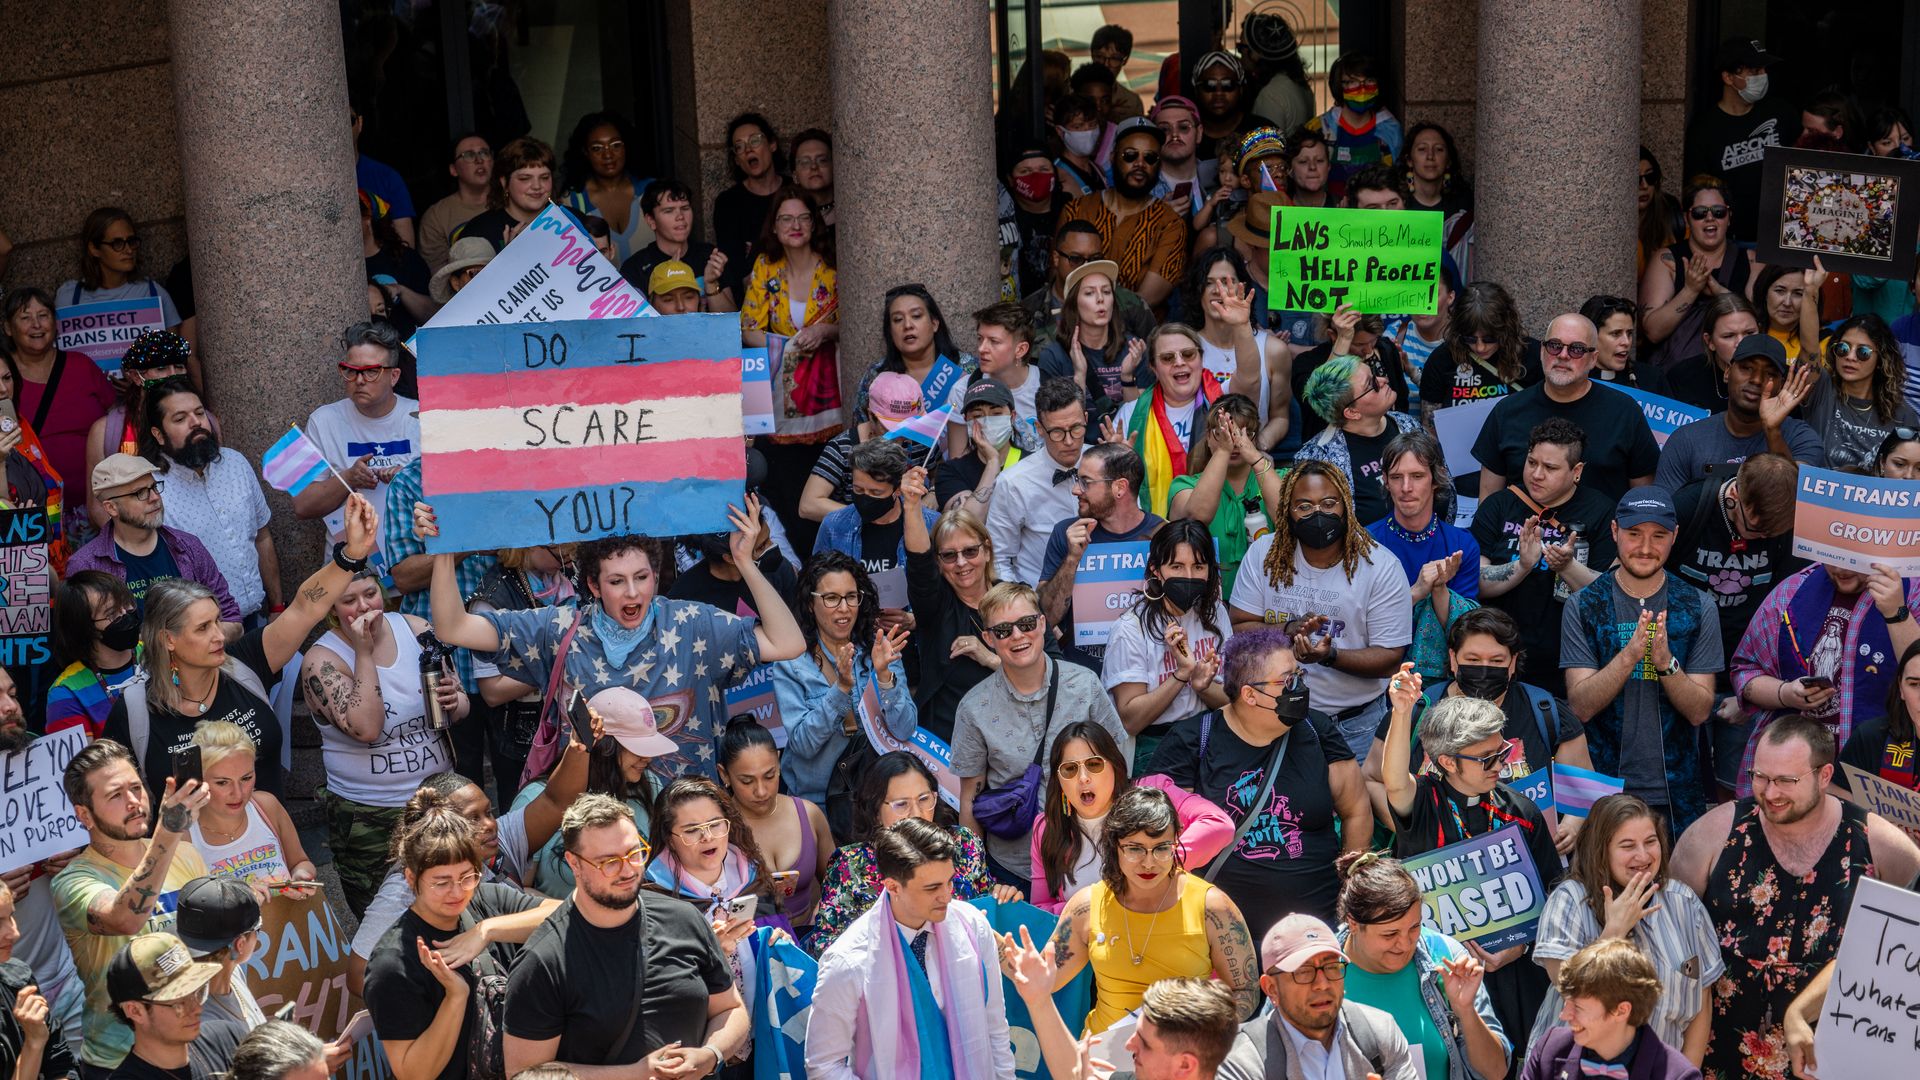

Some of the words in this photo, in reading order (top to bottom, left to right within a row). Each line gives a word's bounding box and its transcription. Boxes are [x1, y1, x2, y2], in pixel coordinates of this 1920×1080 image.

[1722, 132, 1780, 161] AFSCME
[1811, 207, 1864, 219] IMAGINE
[1273, 209, 1330, 251] LAWS
[1338, 223, 1374, 249] Should
[1396, 223, 1432, 247] Made
[1299, 255, 1359, 283] HELP
[1365, 256, 1437, 283] PEOPLE
[498, 262, 550, 315] CANNOT
[541, 288, 565, 311] US
[1285, 280, 1349, 310] NOT
[1359, 290, 1391, 311] HURT
[61, 311, 138, 333] PROTECT
[523, 333, 567, 369] DO
[614, 333, 648, 363] I
[927, 363, 954, 400] KIDS
[1452, 384, 1508, 398] DEACON
[1453, 374, 1482, 387] THIS
[523, 406, 657, 446] SCARE
[1802, 476, 1839, 497] LET
[1843, 484, 1911, 508] TRANS
[0, 513, 46, 543] NS
[534, 487, 635, 541] YOU?
[1828, 521, 1895, 546] GROW
[1111, 552, 1150, 572] TRA
[1697, 548, 1769, 570] TRANS
[1306, 601, 1341, 617] YOUR
[1320, 589, 1340, 603] UP
[724, 666, 774, 695] ANS
[4, 743, 42, 794] EE
[370, 737, 446, 775] DEBAT
[0, 786, 52, 829] OVE
[210, 845, 278, 875] ALICE
[1487, 838, 1522, 870] BE
[241, 901, 351, 980] RAN
[1860, 904, 1920, 977] Tru
[1830, 1000, 1896, 1043] trans
